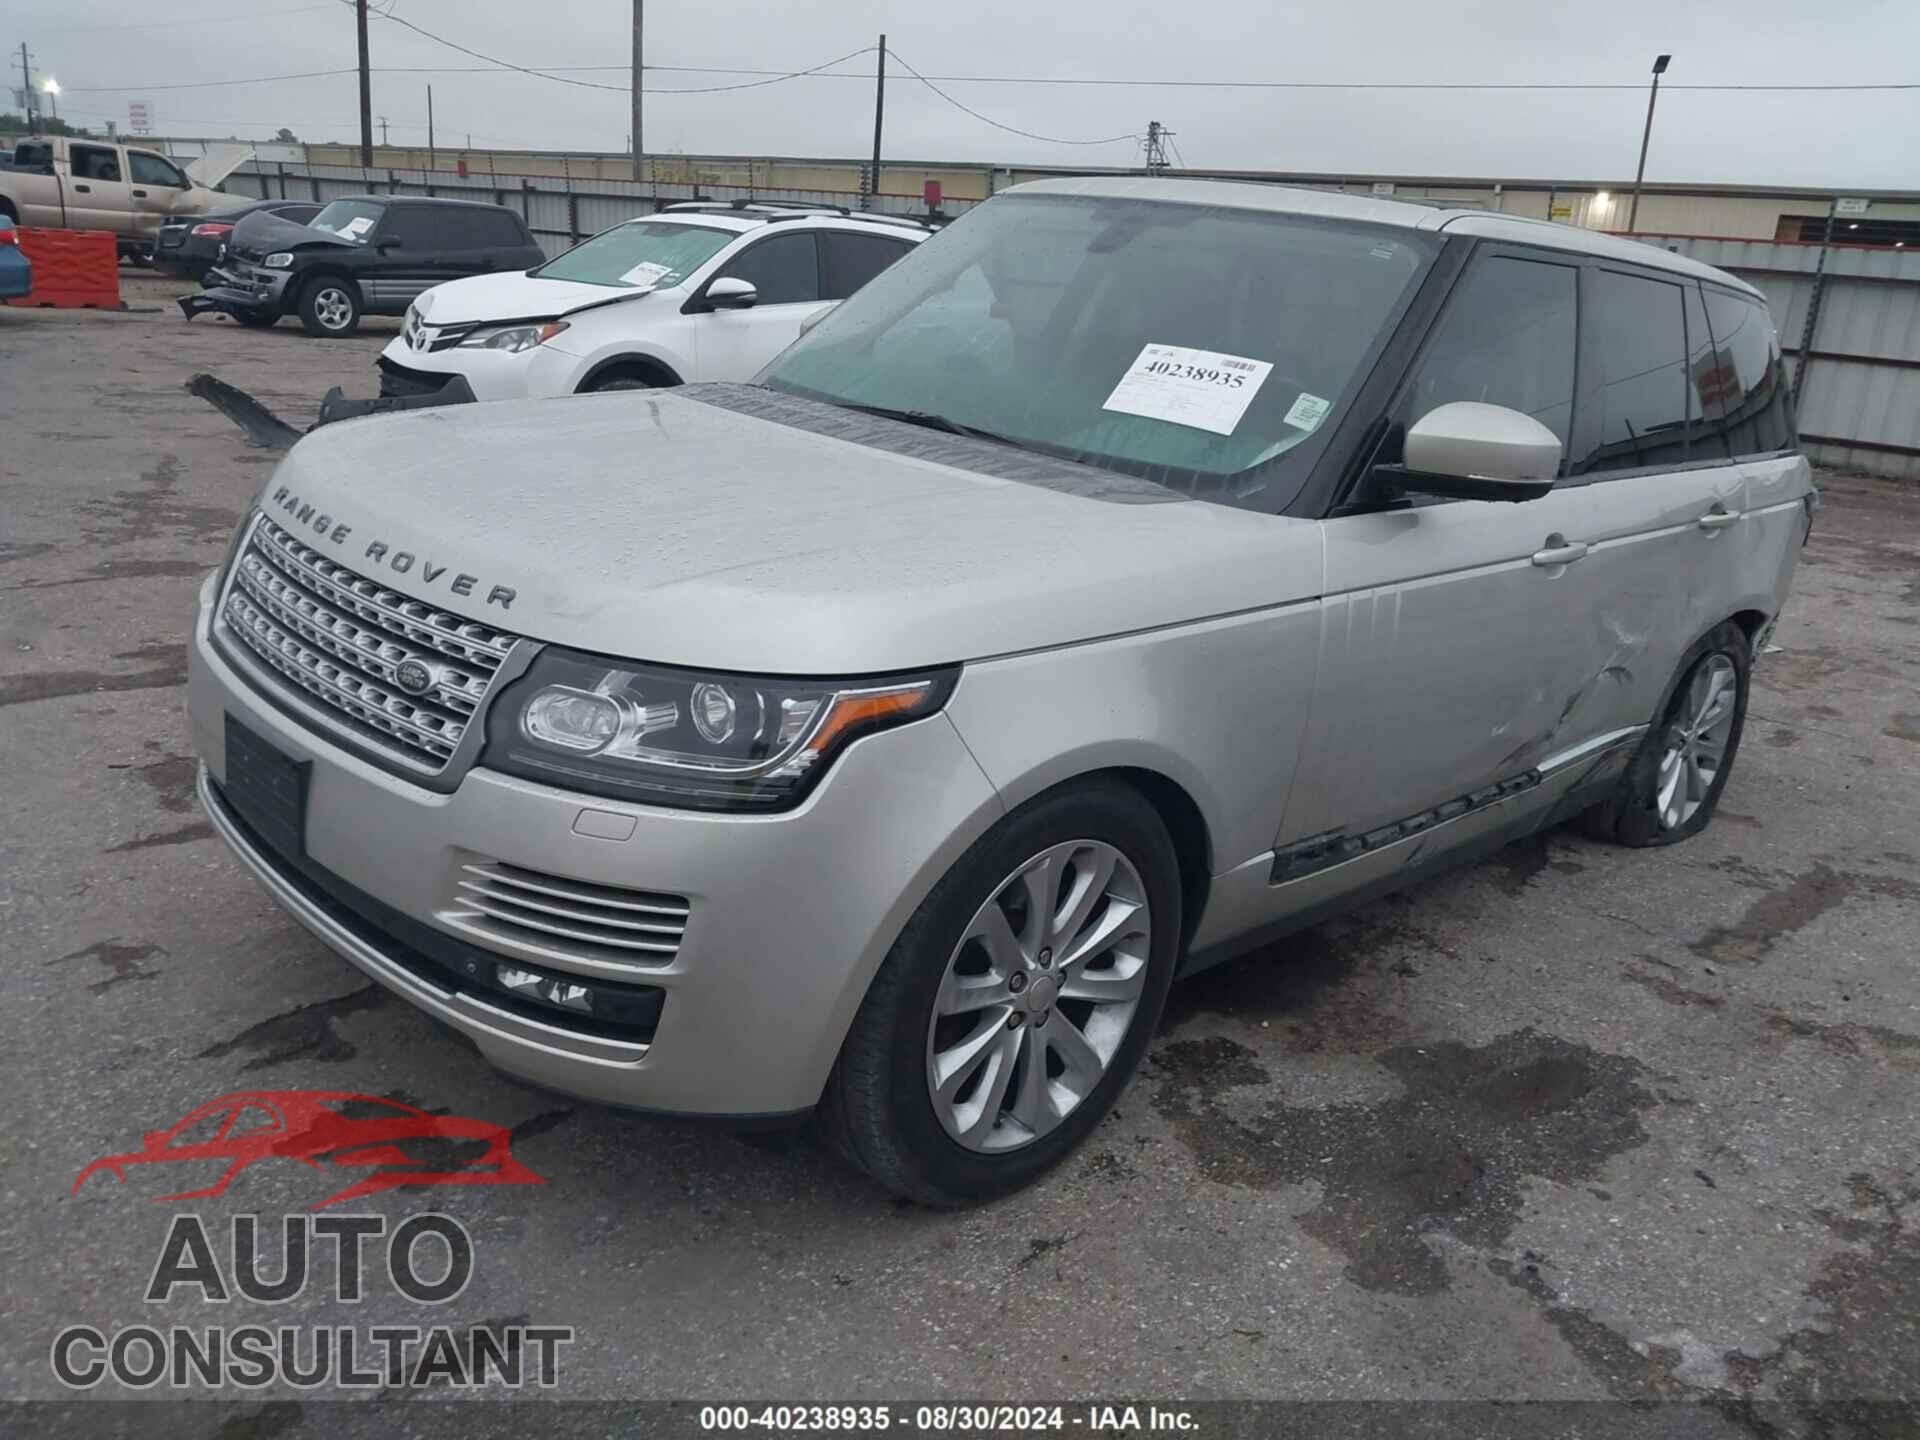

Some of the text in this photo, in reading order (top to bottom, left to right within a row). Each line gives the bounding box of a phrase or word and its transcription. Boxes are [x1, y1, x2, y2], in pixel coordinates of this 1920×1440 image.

[1144, 360, 1246, 389] 40238935
[272, 485, 517, 610] RANGE ROVER
